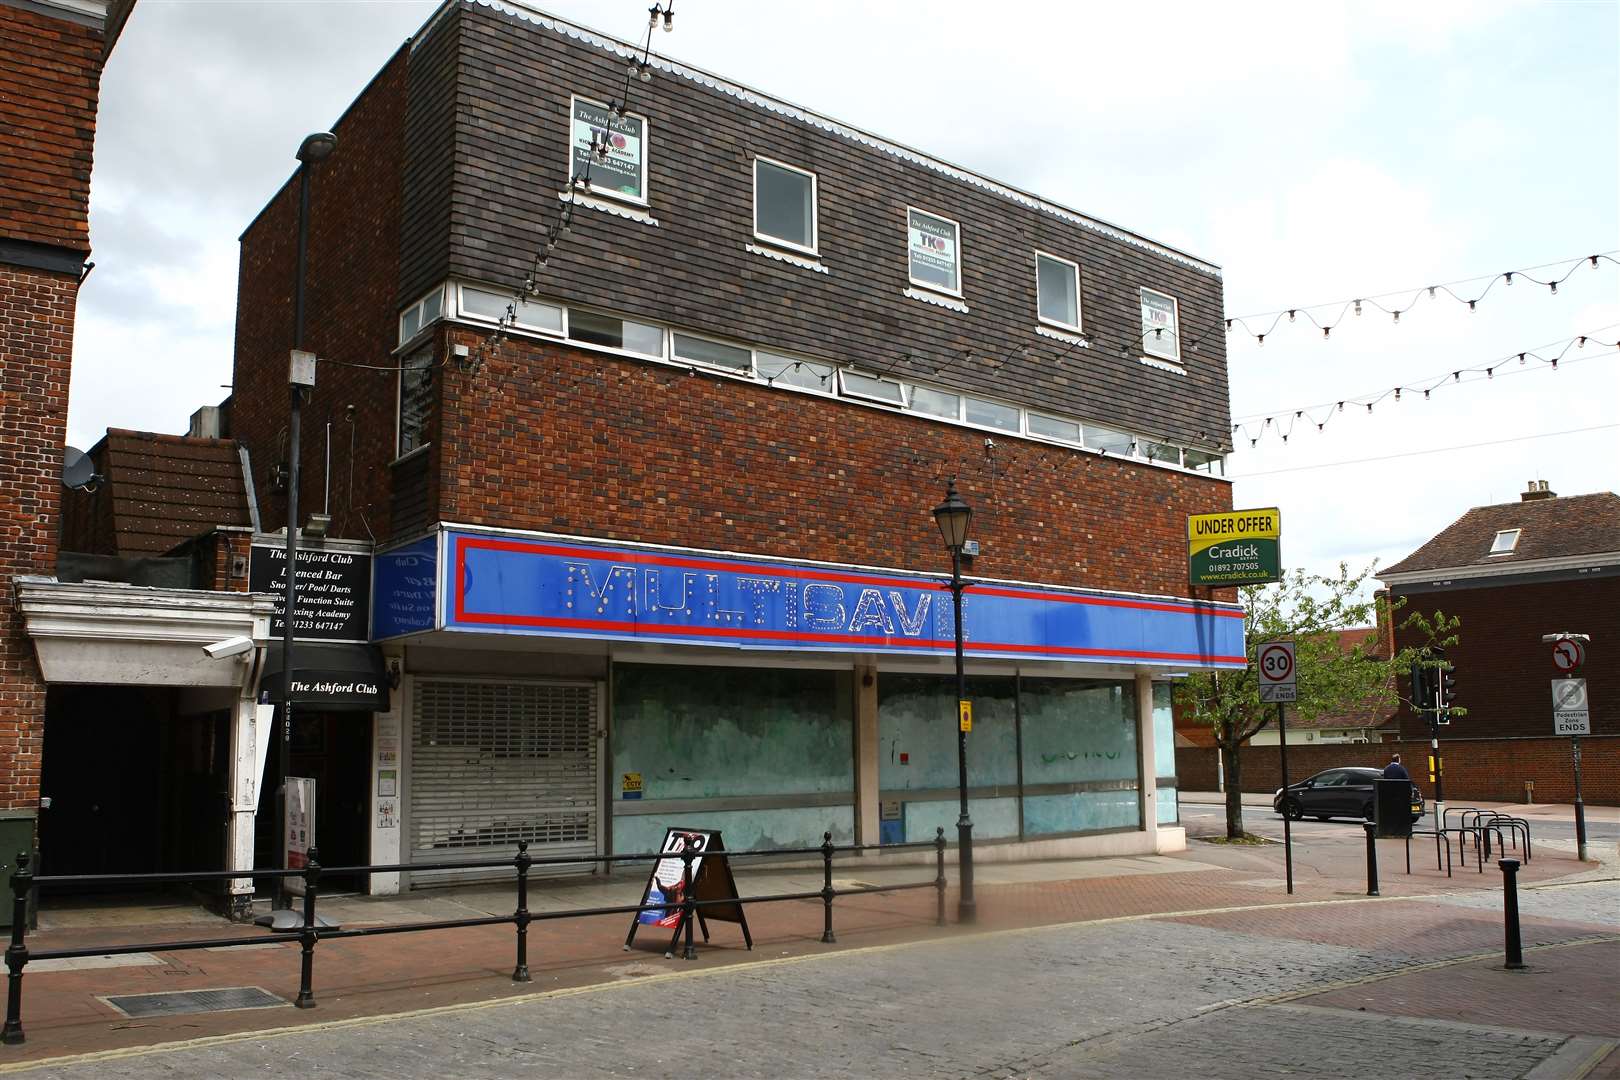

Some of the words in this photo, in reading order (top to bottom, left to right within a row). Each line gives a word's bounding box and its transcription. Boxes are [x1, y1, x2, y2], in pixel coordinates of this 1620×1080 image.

[579, 110, 591, 120] The
[1196, 518, 1234, 534] UNDER
[1237, 516, 1272, 532] OFFER
[1208, 544, 1258, 558] Cradick
[270, 549, 287, 560] The
[330, 554, 353, 565] Club
[1209, 564, 1231, 572] 01892
[1233, 562, 1259, 571] 707505
[325, 571, 343, 581] Bar
[1200, 570, 1268, 581] www.cradick.co.uk
[308, 583, 329, 592] Pool/
[330, 585, 351, 594] Darts
[297, 595, 333, 606] Function
[333, 597, 354, 607] Suite
[315, 609, 351, 620] Academy
[315, 622, 344, 631] 647147
[1266, 656, 1287, 671] 30
[291, 681, 310, 692] The
[312, 682, 353, 695] Ashford
[356, 683, 378, 695] Club
[1560, 723, 1585, 731] ENDS
